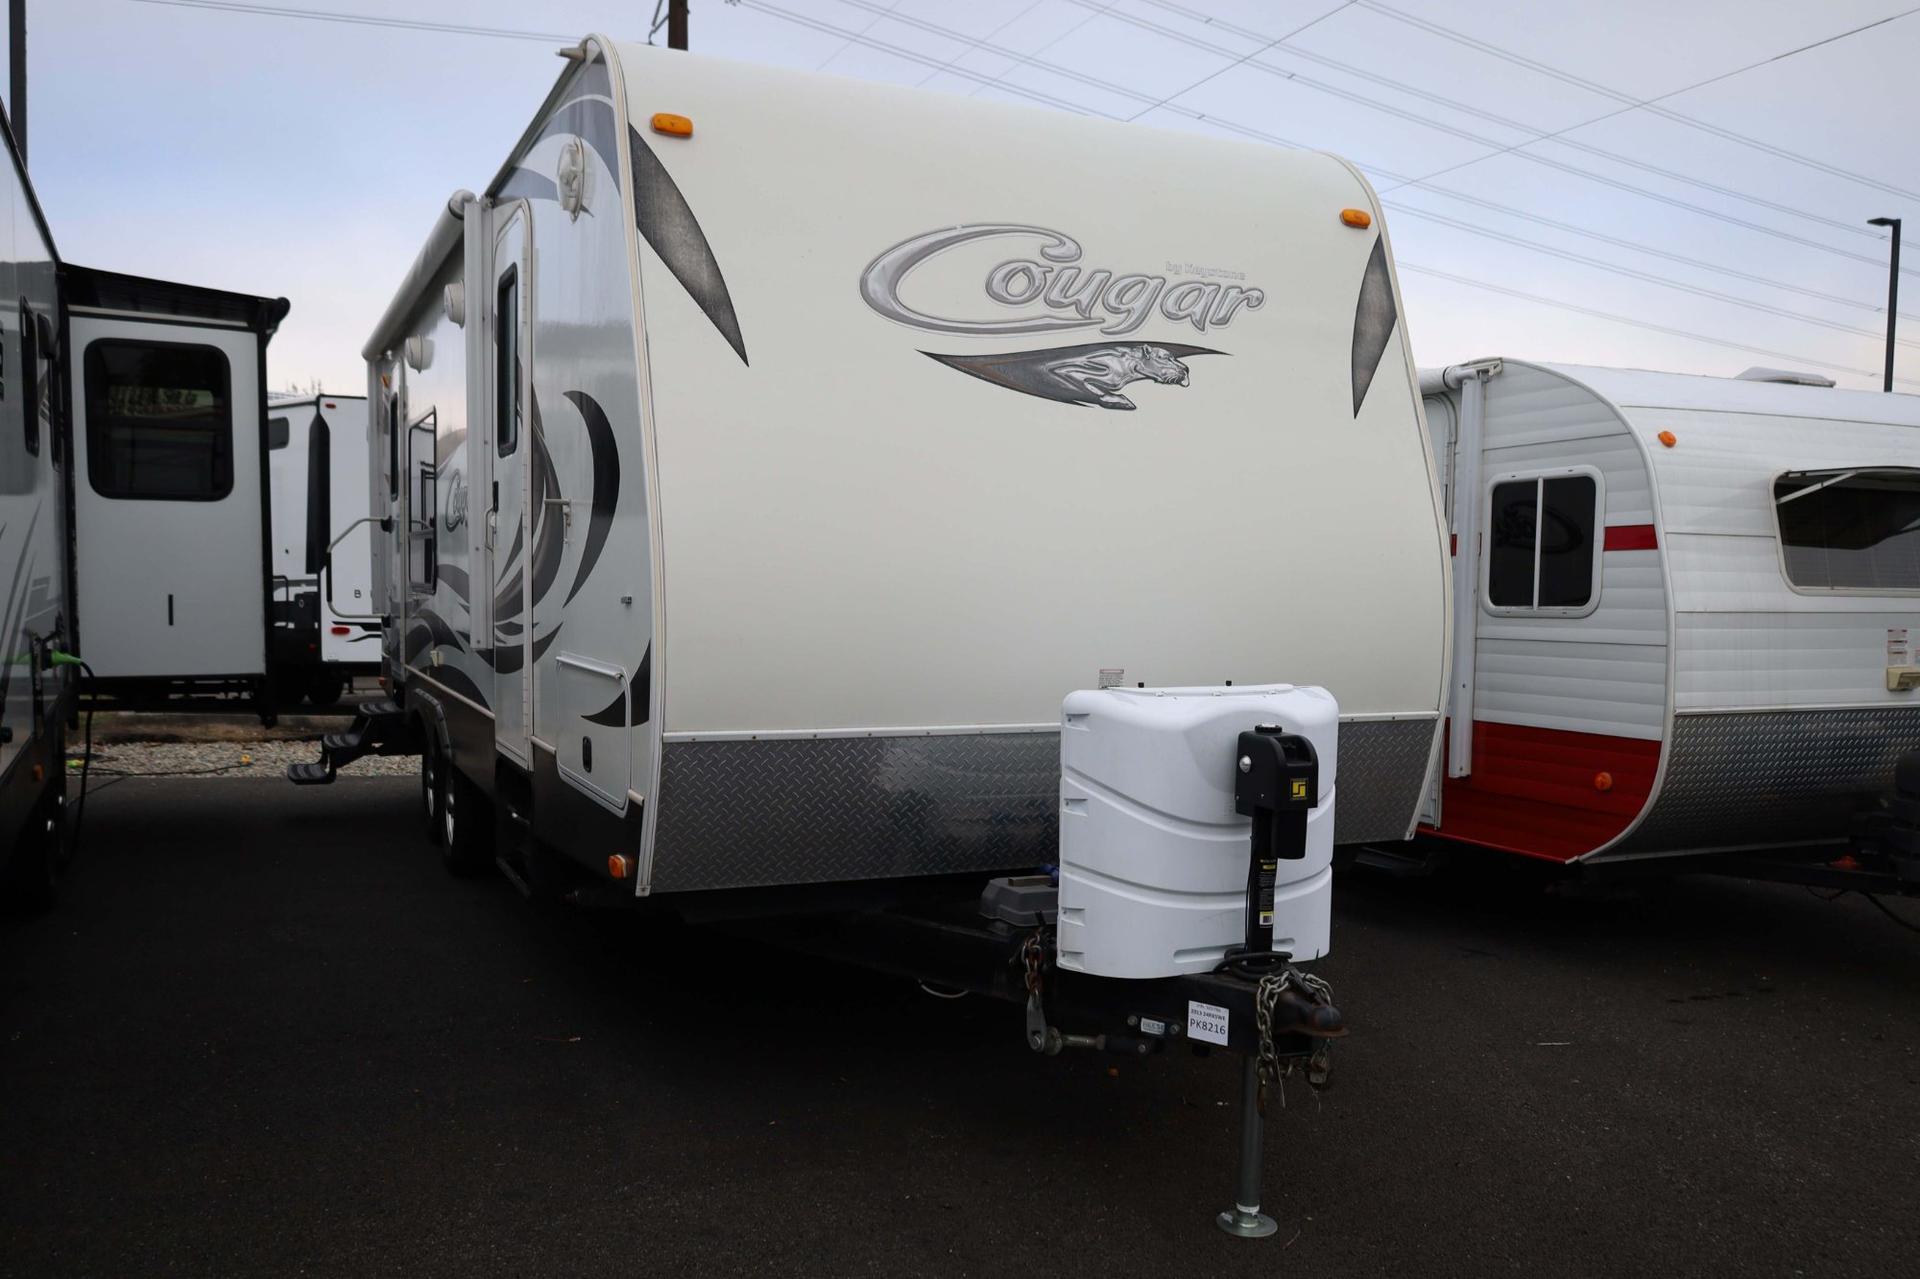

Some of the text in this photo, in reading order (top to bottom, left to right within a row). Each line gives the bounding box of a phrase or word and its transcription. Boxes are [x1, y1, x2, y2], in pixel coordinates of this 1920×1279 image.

[1165, 261, 1182, 274] by
[858, 222, 1265, 336] Cougar
[1190, 1018, 1226, 1035] PK8216
